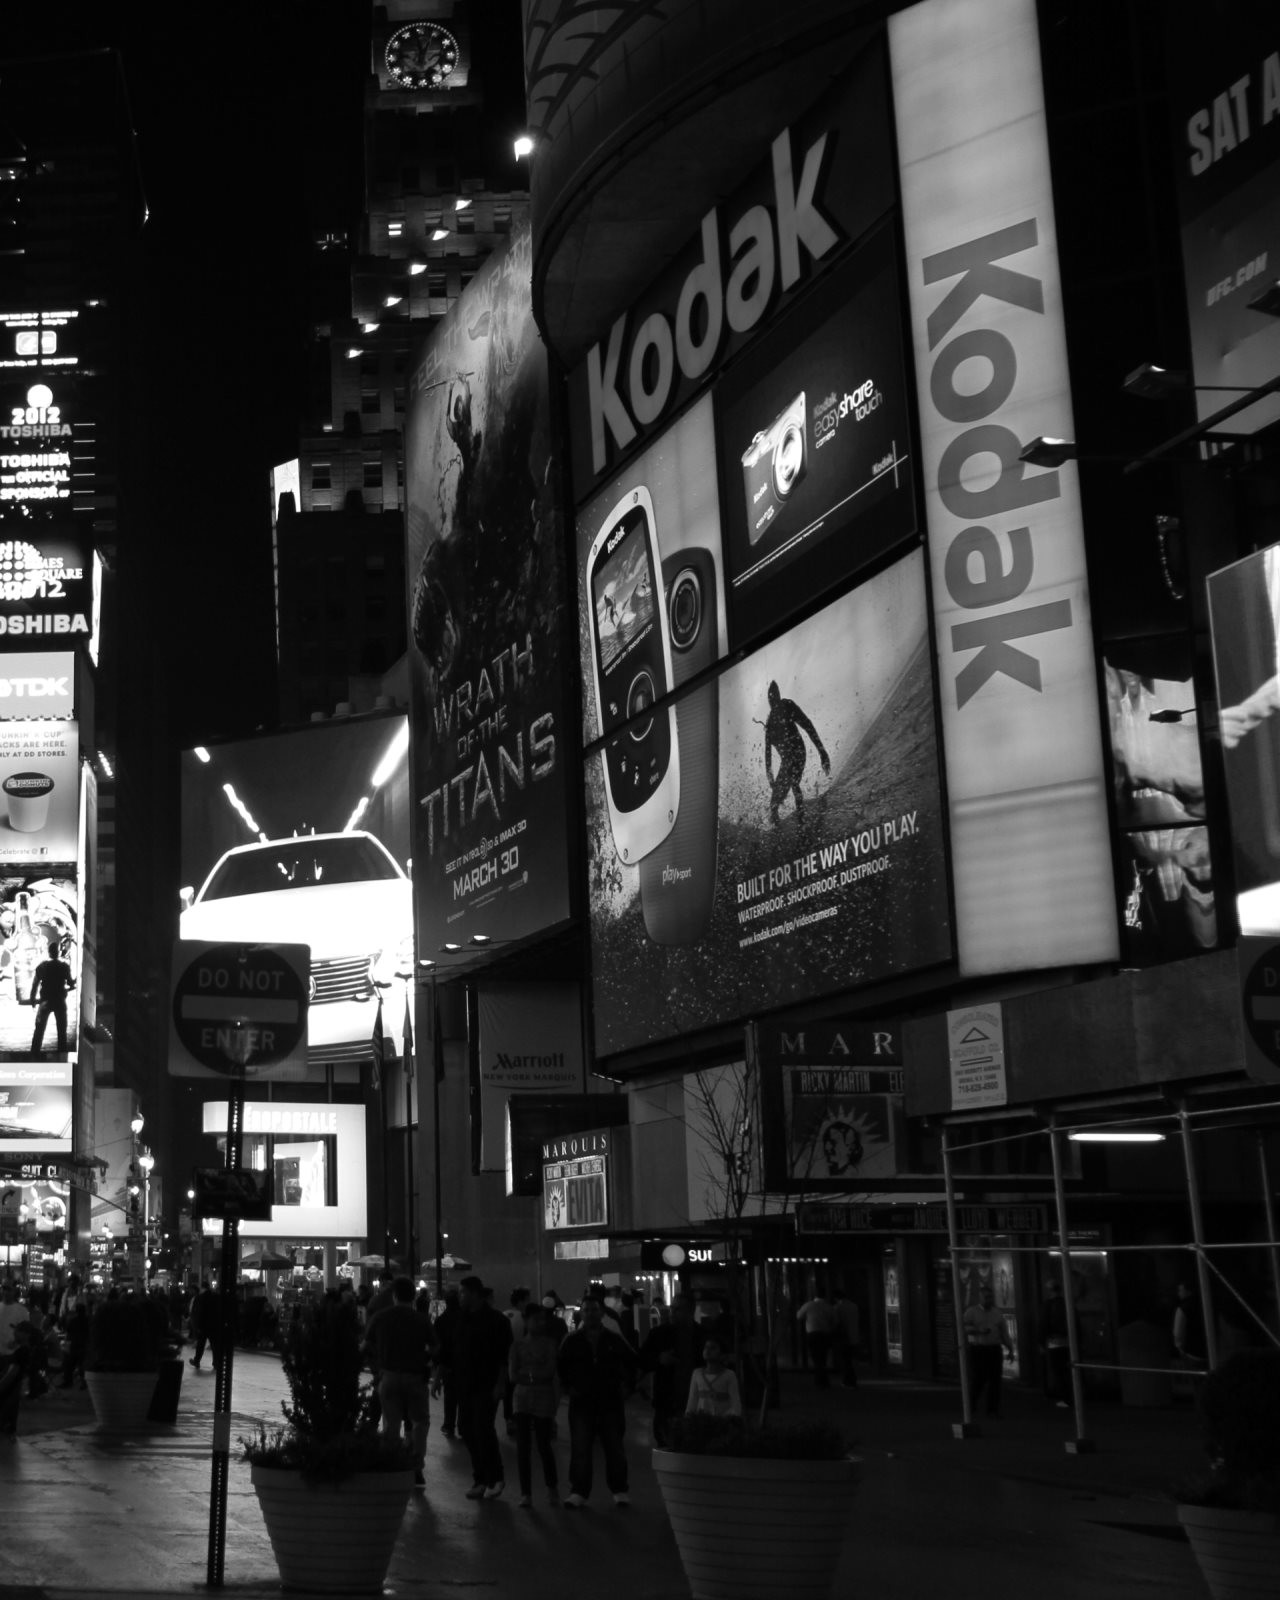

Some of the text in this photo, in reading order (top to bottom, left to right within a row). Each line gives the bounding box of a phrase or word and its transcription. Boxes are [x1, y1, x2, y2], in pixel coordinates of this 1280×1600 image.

[1187, 73, 1251, 177] SAT
[586, 126, 839, 476] Kodak
[11, 406, 61, 425] 2012
[813, 391, 838, 419] Kodak
[855, 389, 883, 422] touch
[0, 424, 72, 438] TOSHIBA
[0, 452, 71, 468] TOSHIBA
[921, 217, 1073, 711] Kodak
[607, 526, 626, 554] Kodak
[9, 676, 70, 697] TDK
[433, 632, 535, 744] WRATH
[23, 740, 40, 748] ARE
[42, 740, 68, 748] HERE.
[420, 711, 556, 856] TITANS
[445, 860, 457, 874] SEE
[499, 825, 517, 843] IMAX
[517, 819, 527, 834] 3D
[737, 810, 920, 904] BUILT FOR THE WAY YOU PLAY.
[453, 857, 498, 901] MARCH
[501, 845, 519, 875] 30
[738, 855, 892, 925] WATERPROOF. SHOCKPROOF. DUSTPROOF.
[738, 905, 838, 948] www.kodak.com/go/videocameras
[198, 967, 285, 991] DO NOT
[201, 1027, 276, 1051] ENTER
[491, 1052, 565, 1070] Marriott
[483, 1073, 504, 1081] NEW
[534, 1073, 577, 1082] MARQUIS
[801, 1071, 830, 1093] RICKY
[833, 1071, 870, 1093] MARTIN
[542, 1134, 607, 1159] MARQUIS
[21, 1164, 42, 1178] SUIT
